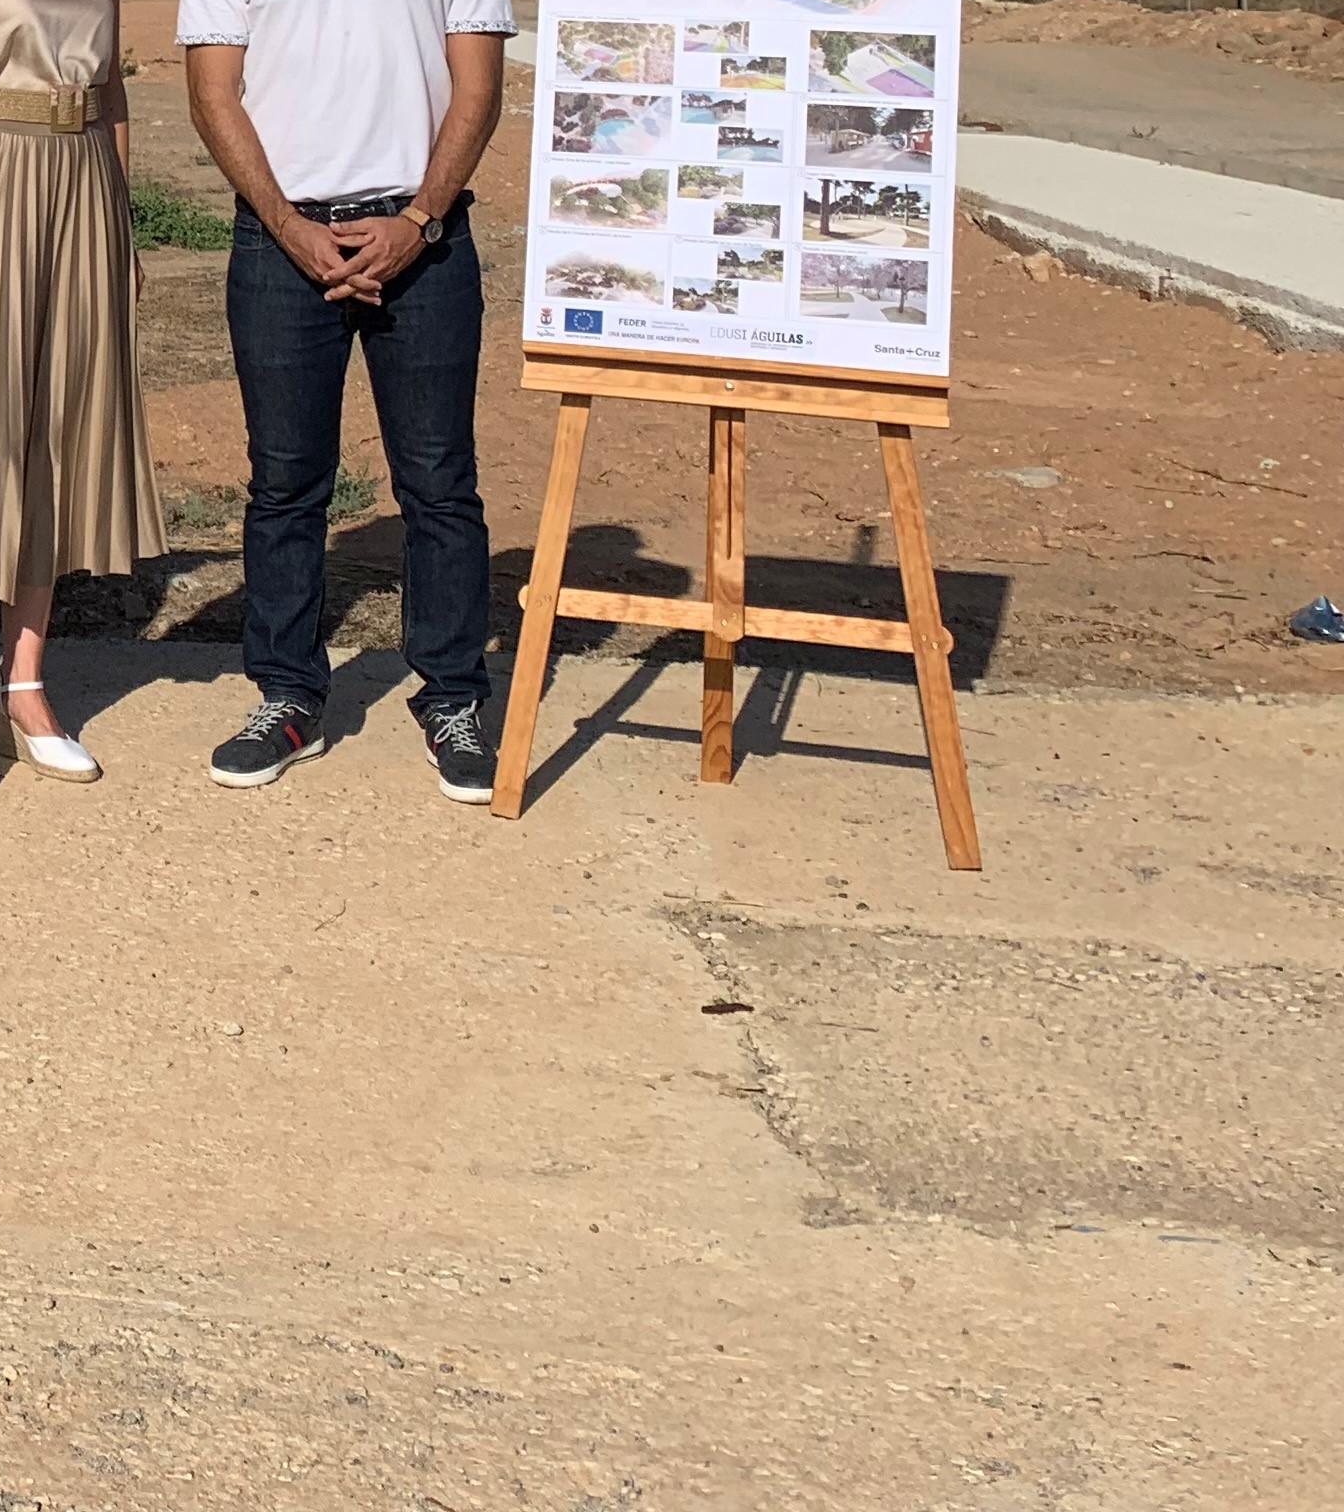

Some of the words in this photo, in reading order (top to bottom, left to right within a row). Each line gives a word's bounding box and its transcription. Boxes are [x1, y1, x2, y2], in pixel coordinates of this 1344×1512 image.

[618, 317, 647, 327] FEDER
[710, 326, 747, 340] EDUSI
[750, 328, 804, 345] ÁGUILAS
